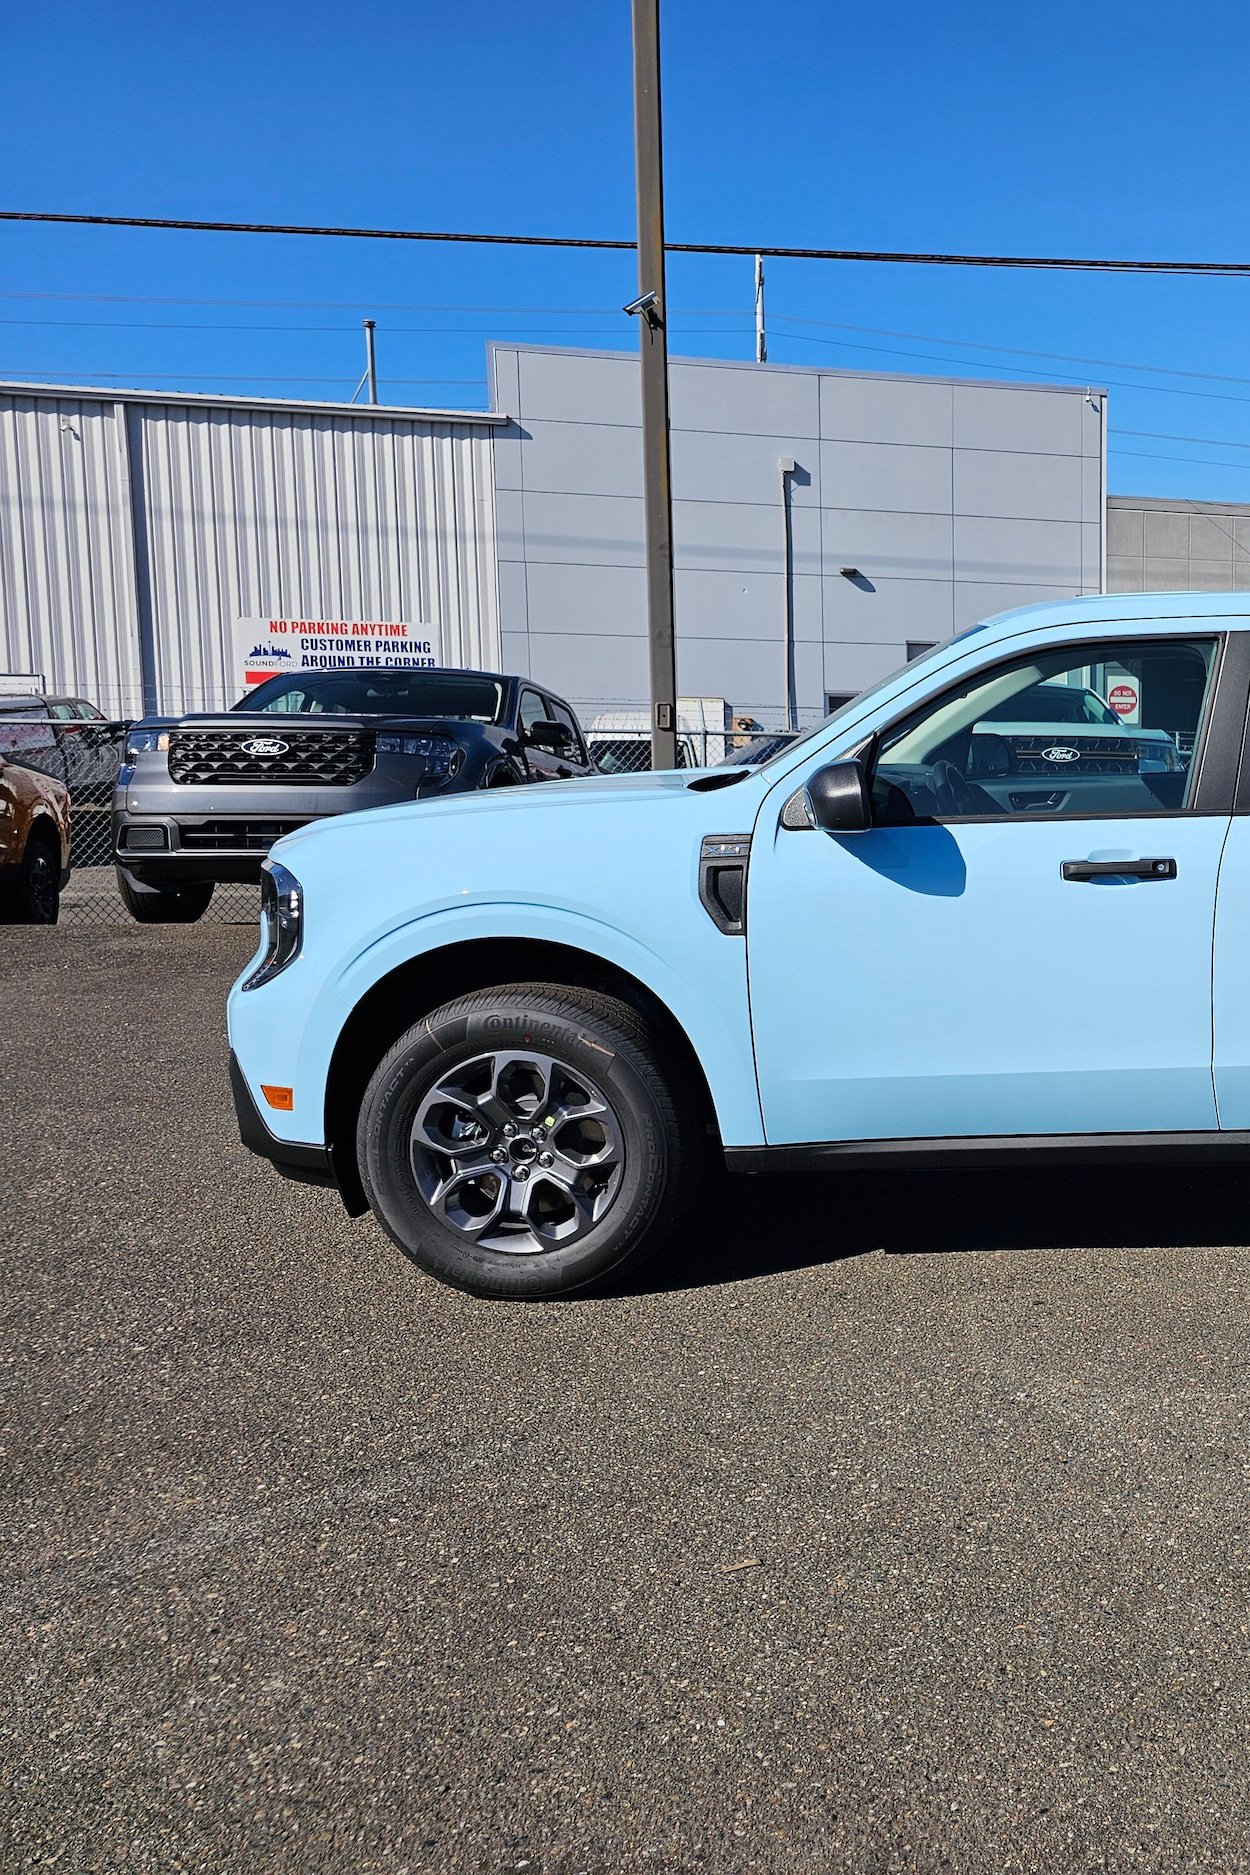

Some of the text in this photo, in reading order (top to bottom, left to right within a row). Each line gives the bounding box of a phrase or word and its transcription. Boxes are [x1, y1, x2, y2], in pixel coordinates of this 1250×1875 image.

[269, 620, 408, 637] NO PARKING ANYTIME
[300, 638, 431, 653] CUSTOMER PARKING
[301, 654, 435, 668] AROUND THE CORNER
[704, 843, 748, 856] XLT
